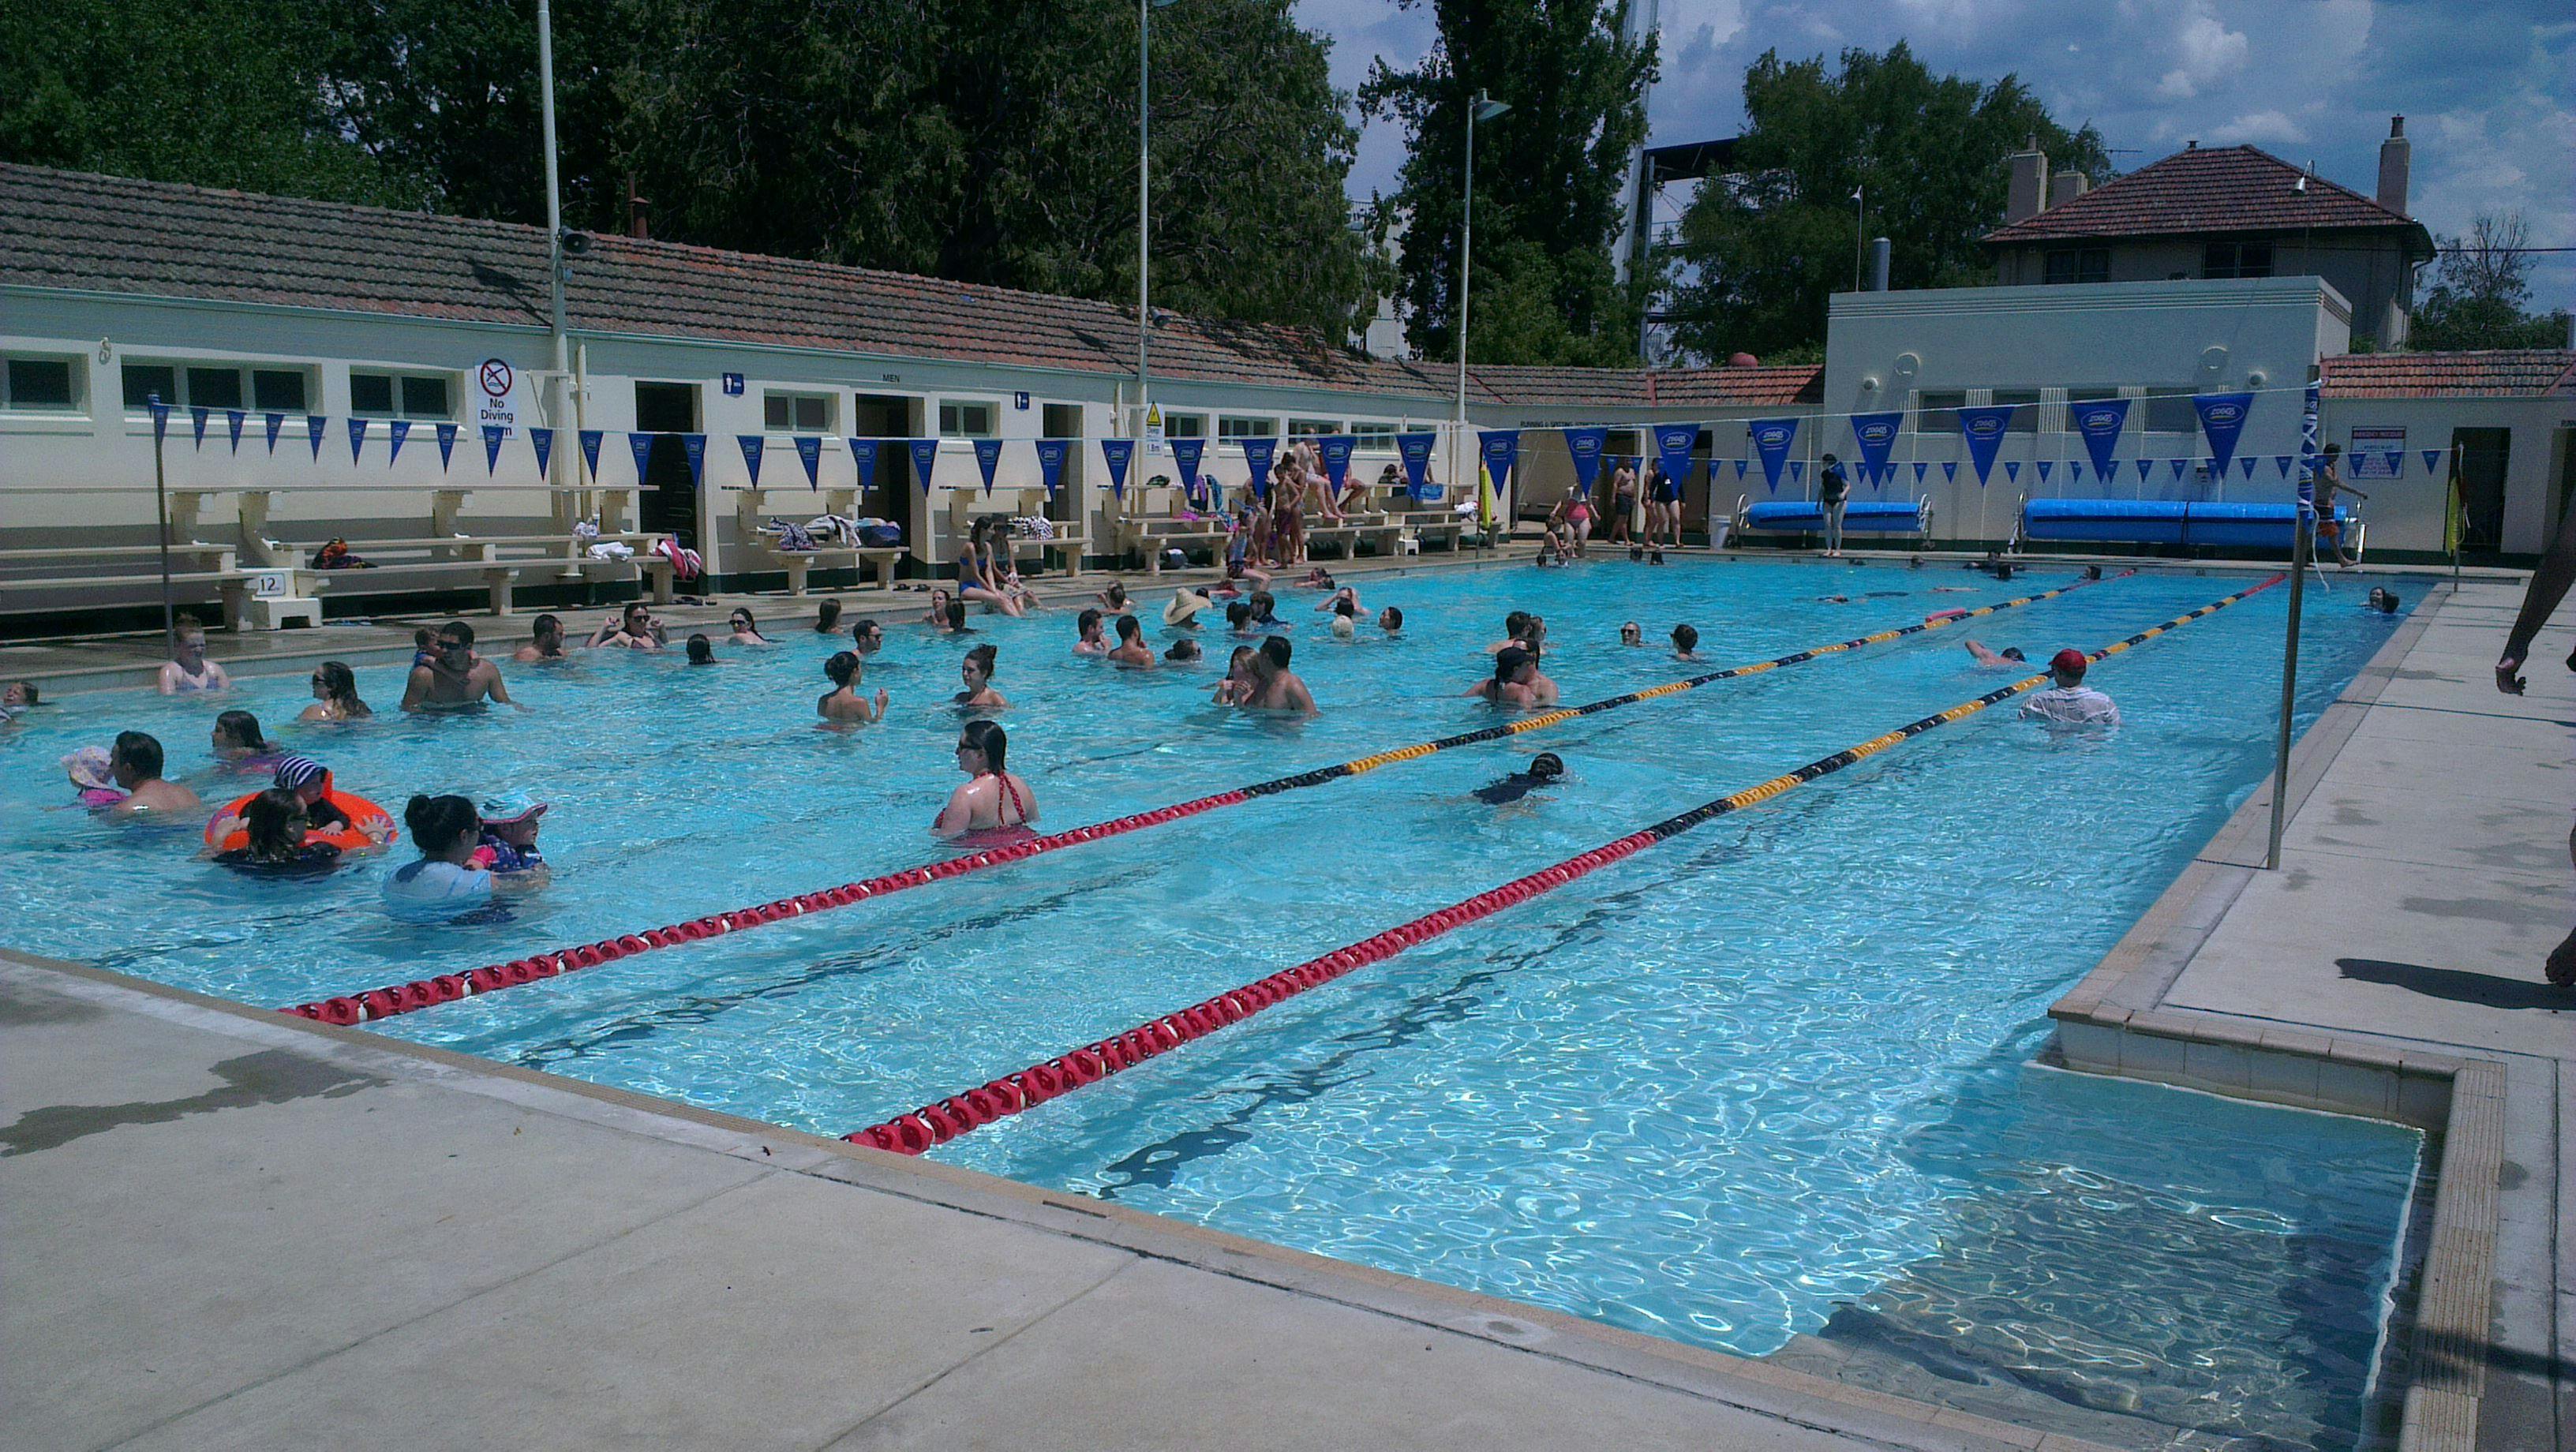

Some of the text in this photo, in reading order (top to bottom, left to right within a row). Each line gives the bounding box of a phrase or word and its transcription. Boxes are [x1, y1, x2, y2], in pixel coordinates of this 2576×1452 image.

[882, 373, 900, 383] MEN
[489, 398, 505, 409] No
[2211, 407, 2236, 416] ZOGGS
[481, 410, 514, 424] Diving
[2088, 414, 2113, 423] ZOGGS
[1974, 419, 1998, 428] ZOGGS
